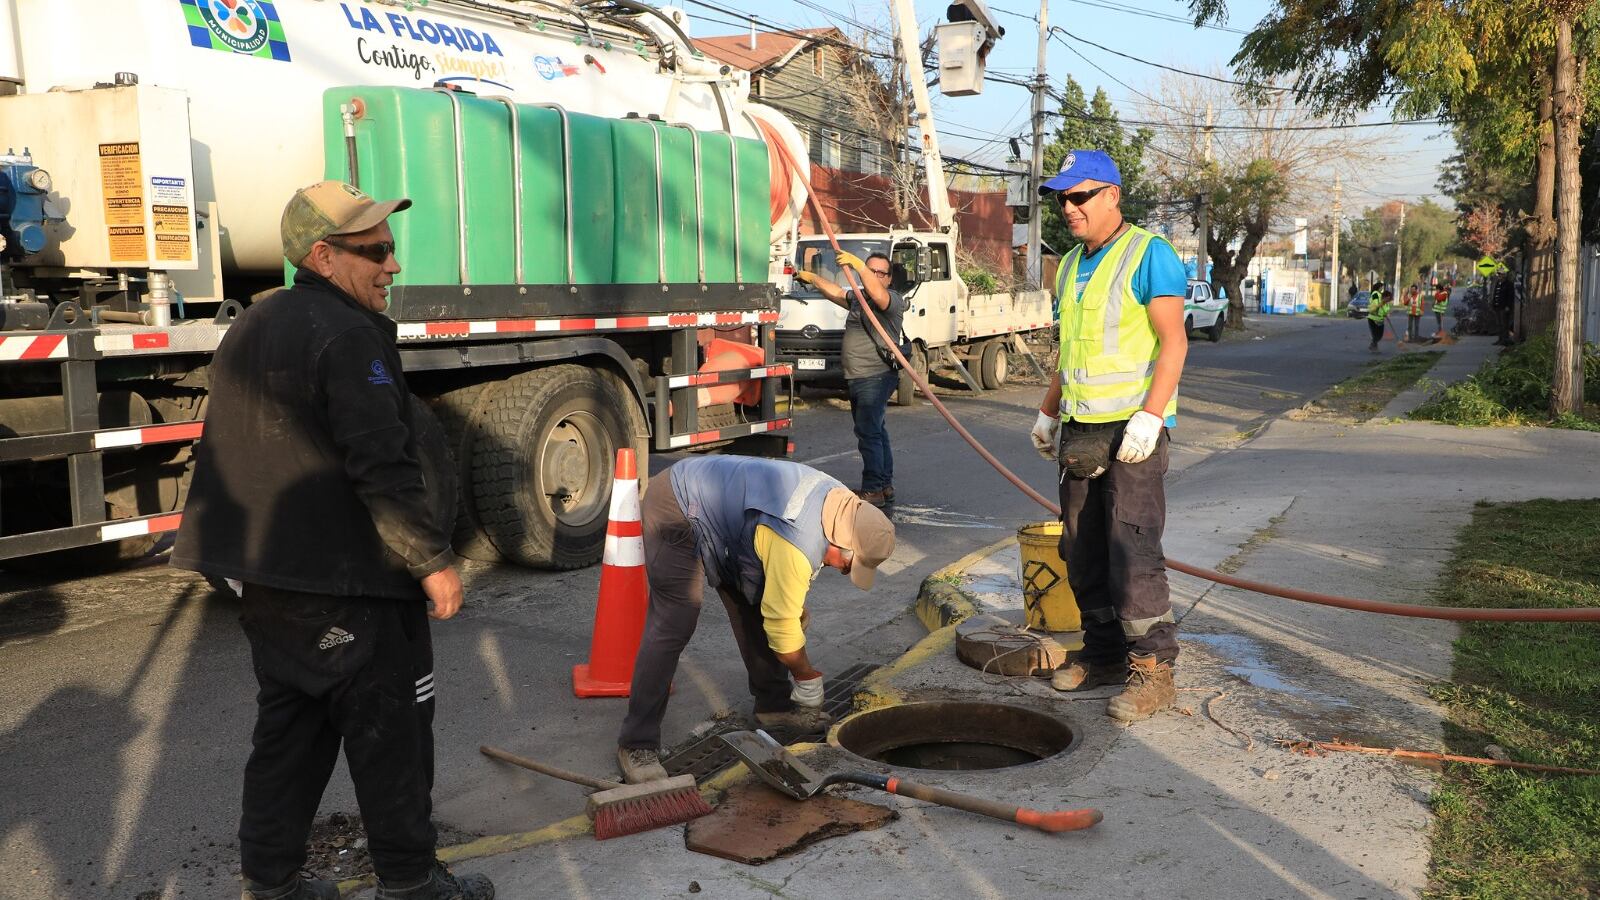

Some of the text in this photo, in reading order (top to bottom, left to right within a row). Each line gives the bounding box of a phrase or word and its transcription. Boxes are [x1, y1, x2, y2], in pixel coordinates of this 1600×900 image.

[208, 19, 266, 50] MUNICIPALIDAD
[340, 3, 504, 57] LA FLORIDA
[357, 37, 436, 81] Contigo,
[152, 178, 184, 186] IMPORTANTE
[319, 633, 355, 650] adidas
